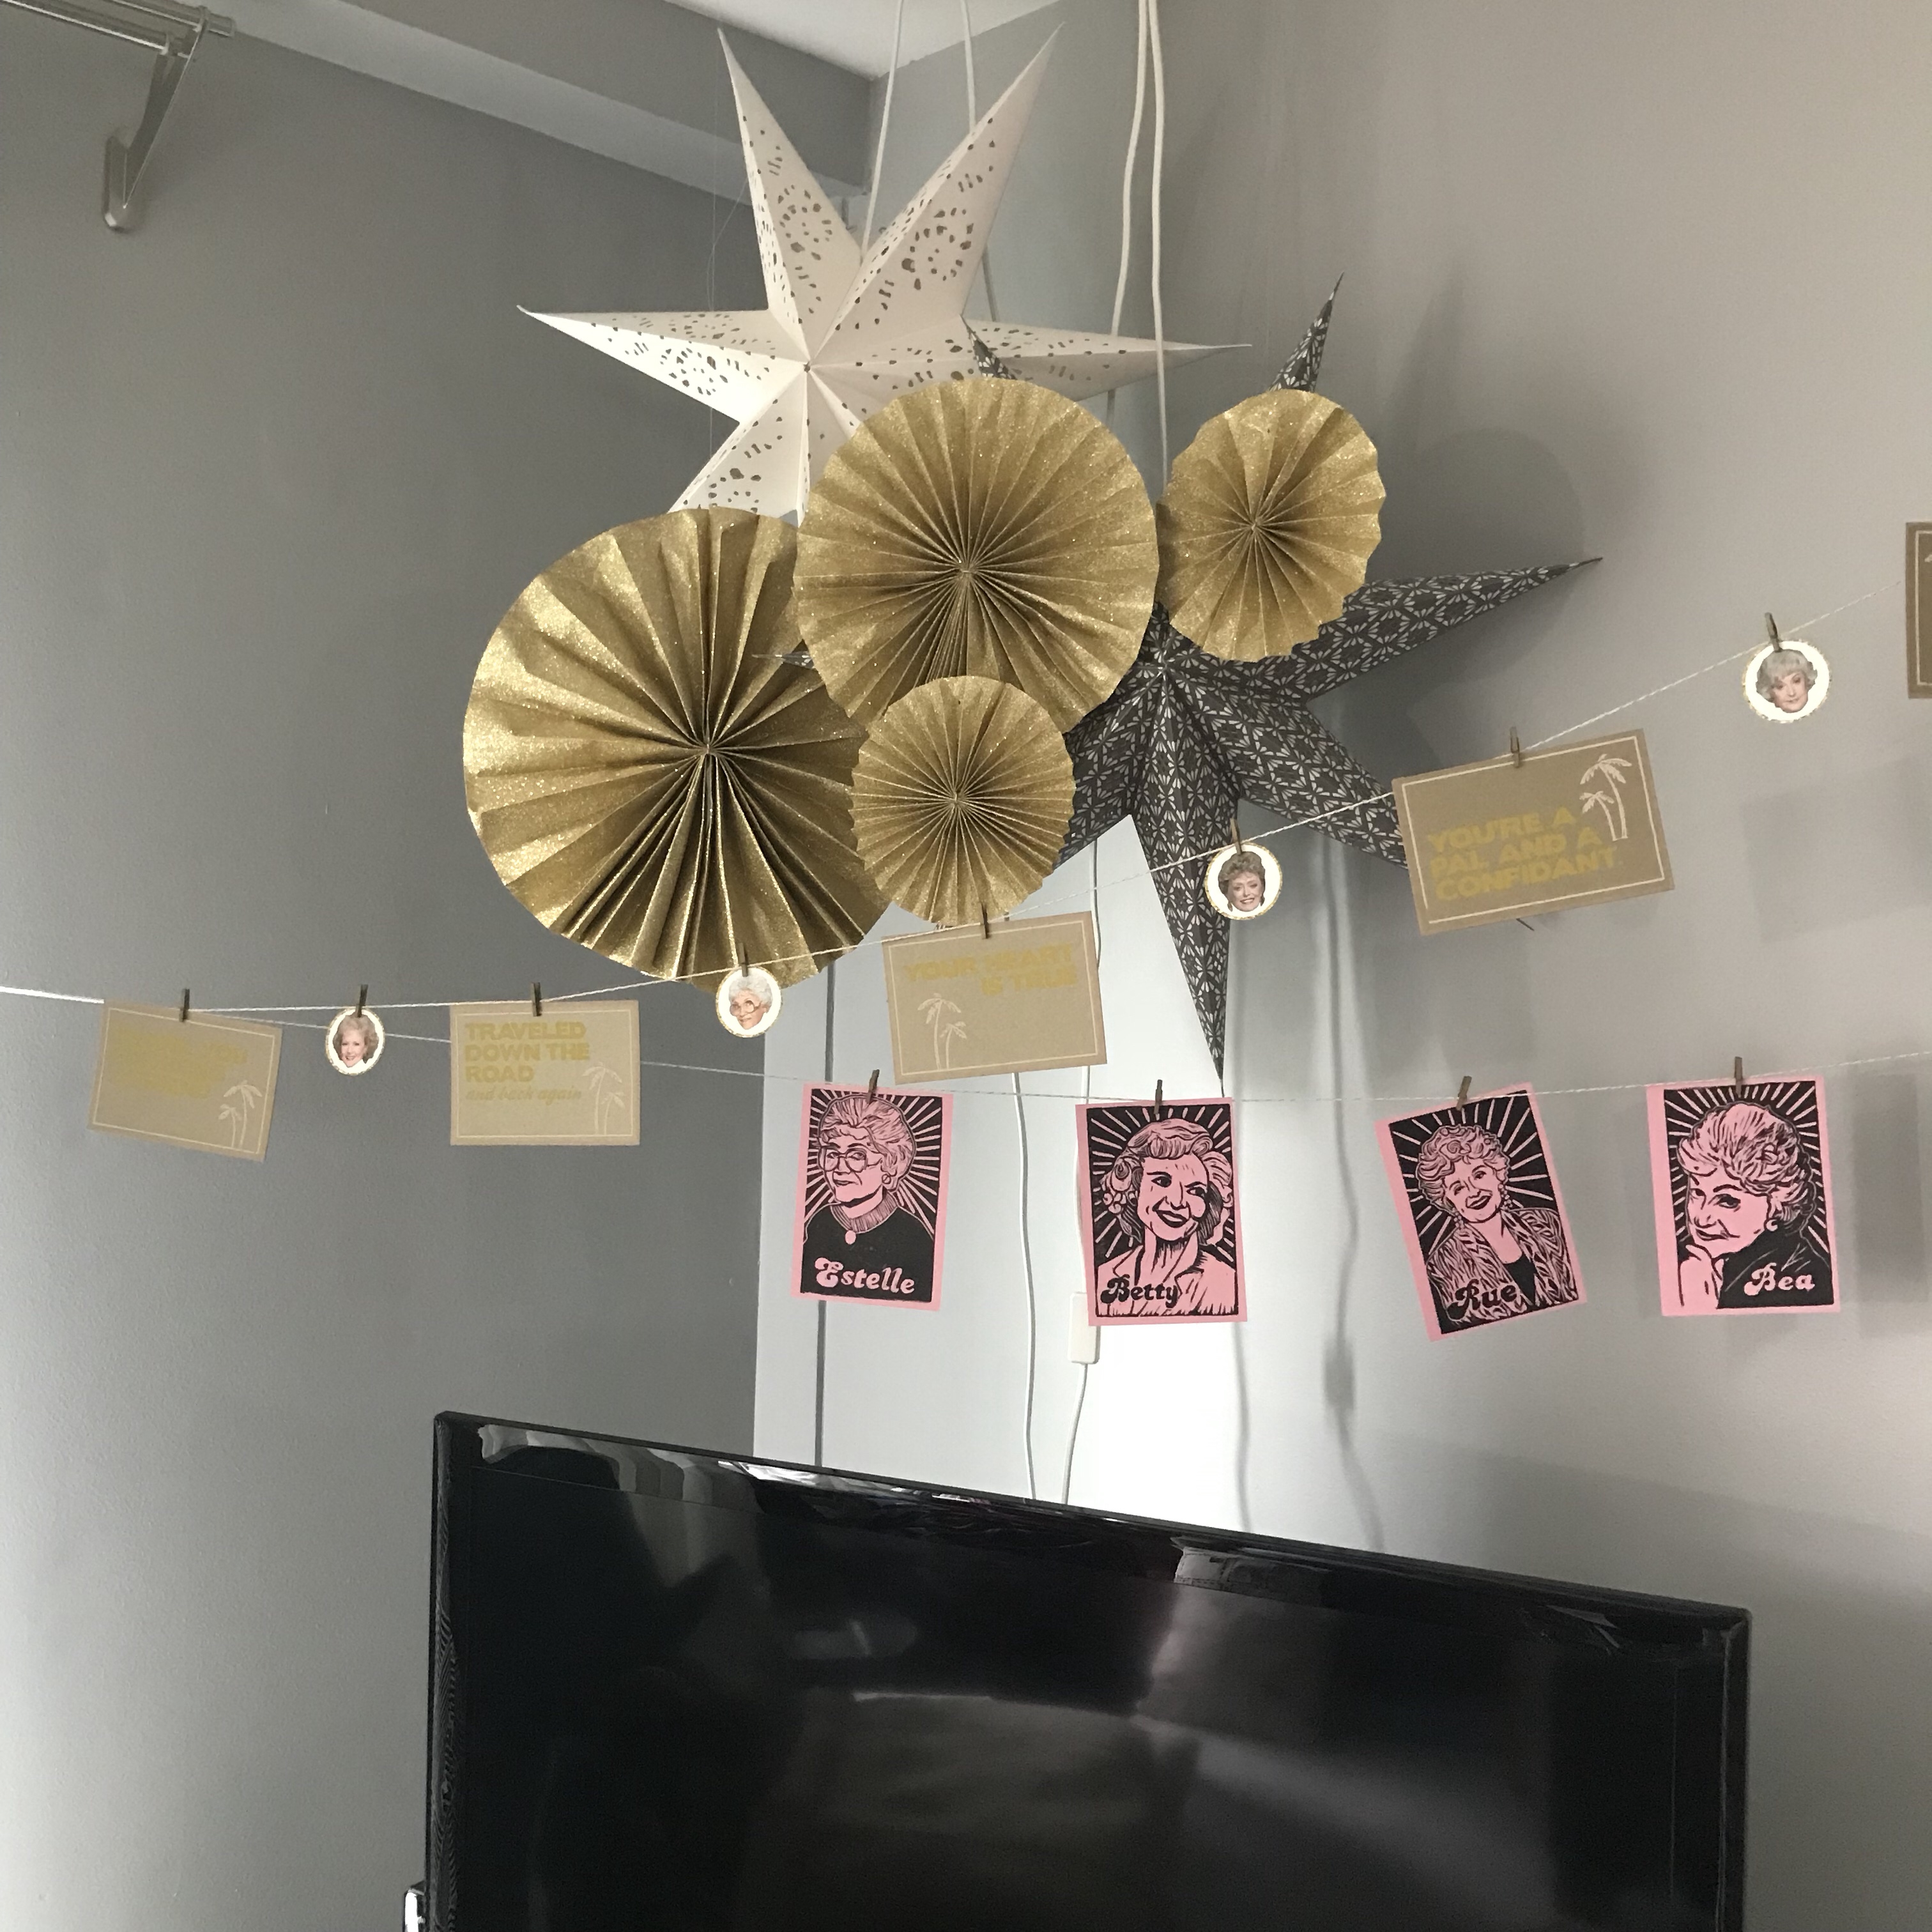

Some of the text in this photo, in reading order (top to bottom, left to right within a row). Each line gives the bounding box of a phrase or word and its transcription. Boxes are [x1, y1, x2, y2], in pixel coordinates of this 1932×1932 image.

[1552, 808, 1575, 826] A
[1430, 827, 1602, 876] PAL AND A
[464, 1022, 586, 1040] TRAVELED
[464, 1043, 590, 1061] DOWN THE
[465, 1065, 534, 1083] ROAD
[465, 1085, 582, 1106] and back again
[815, 1257, 916, 1294] Estelle
[1744, 1262, 1815, 1296] Bea
[1100, 1274, 1181, 1308] Betty
[1446, 1278, 1517, 1320] Rue
